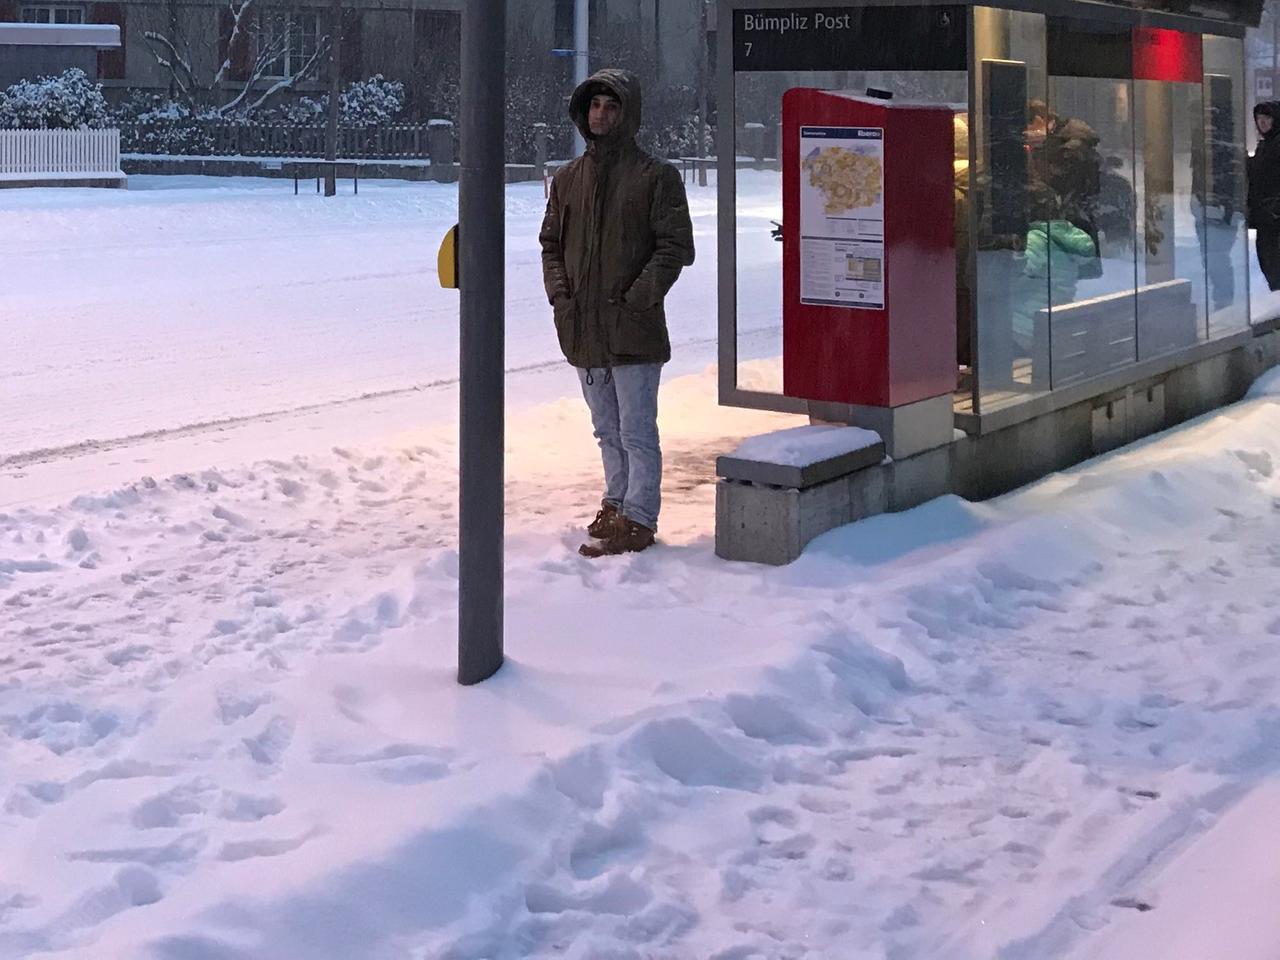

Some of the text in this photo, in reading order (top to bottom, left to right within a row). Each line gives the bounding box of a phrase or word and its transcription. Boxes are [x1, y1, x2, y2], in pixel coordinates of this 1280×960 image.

[744, 12, 851, 34] Bümpliz Post
[744, 42, 753, 57] 7
